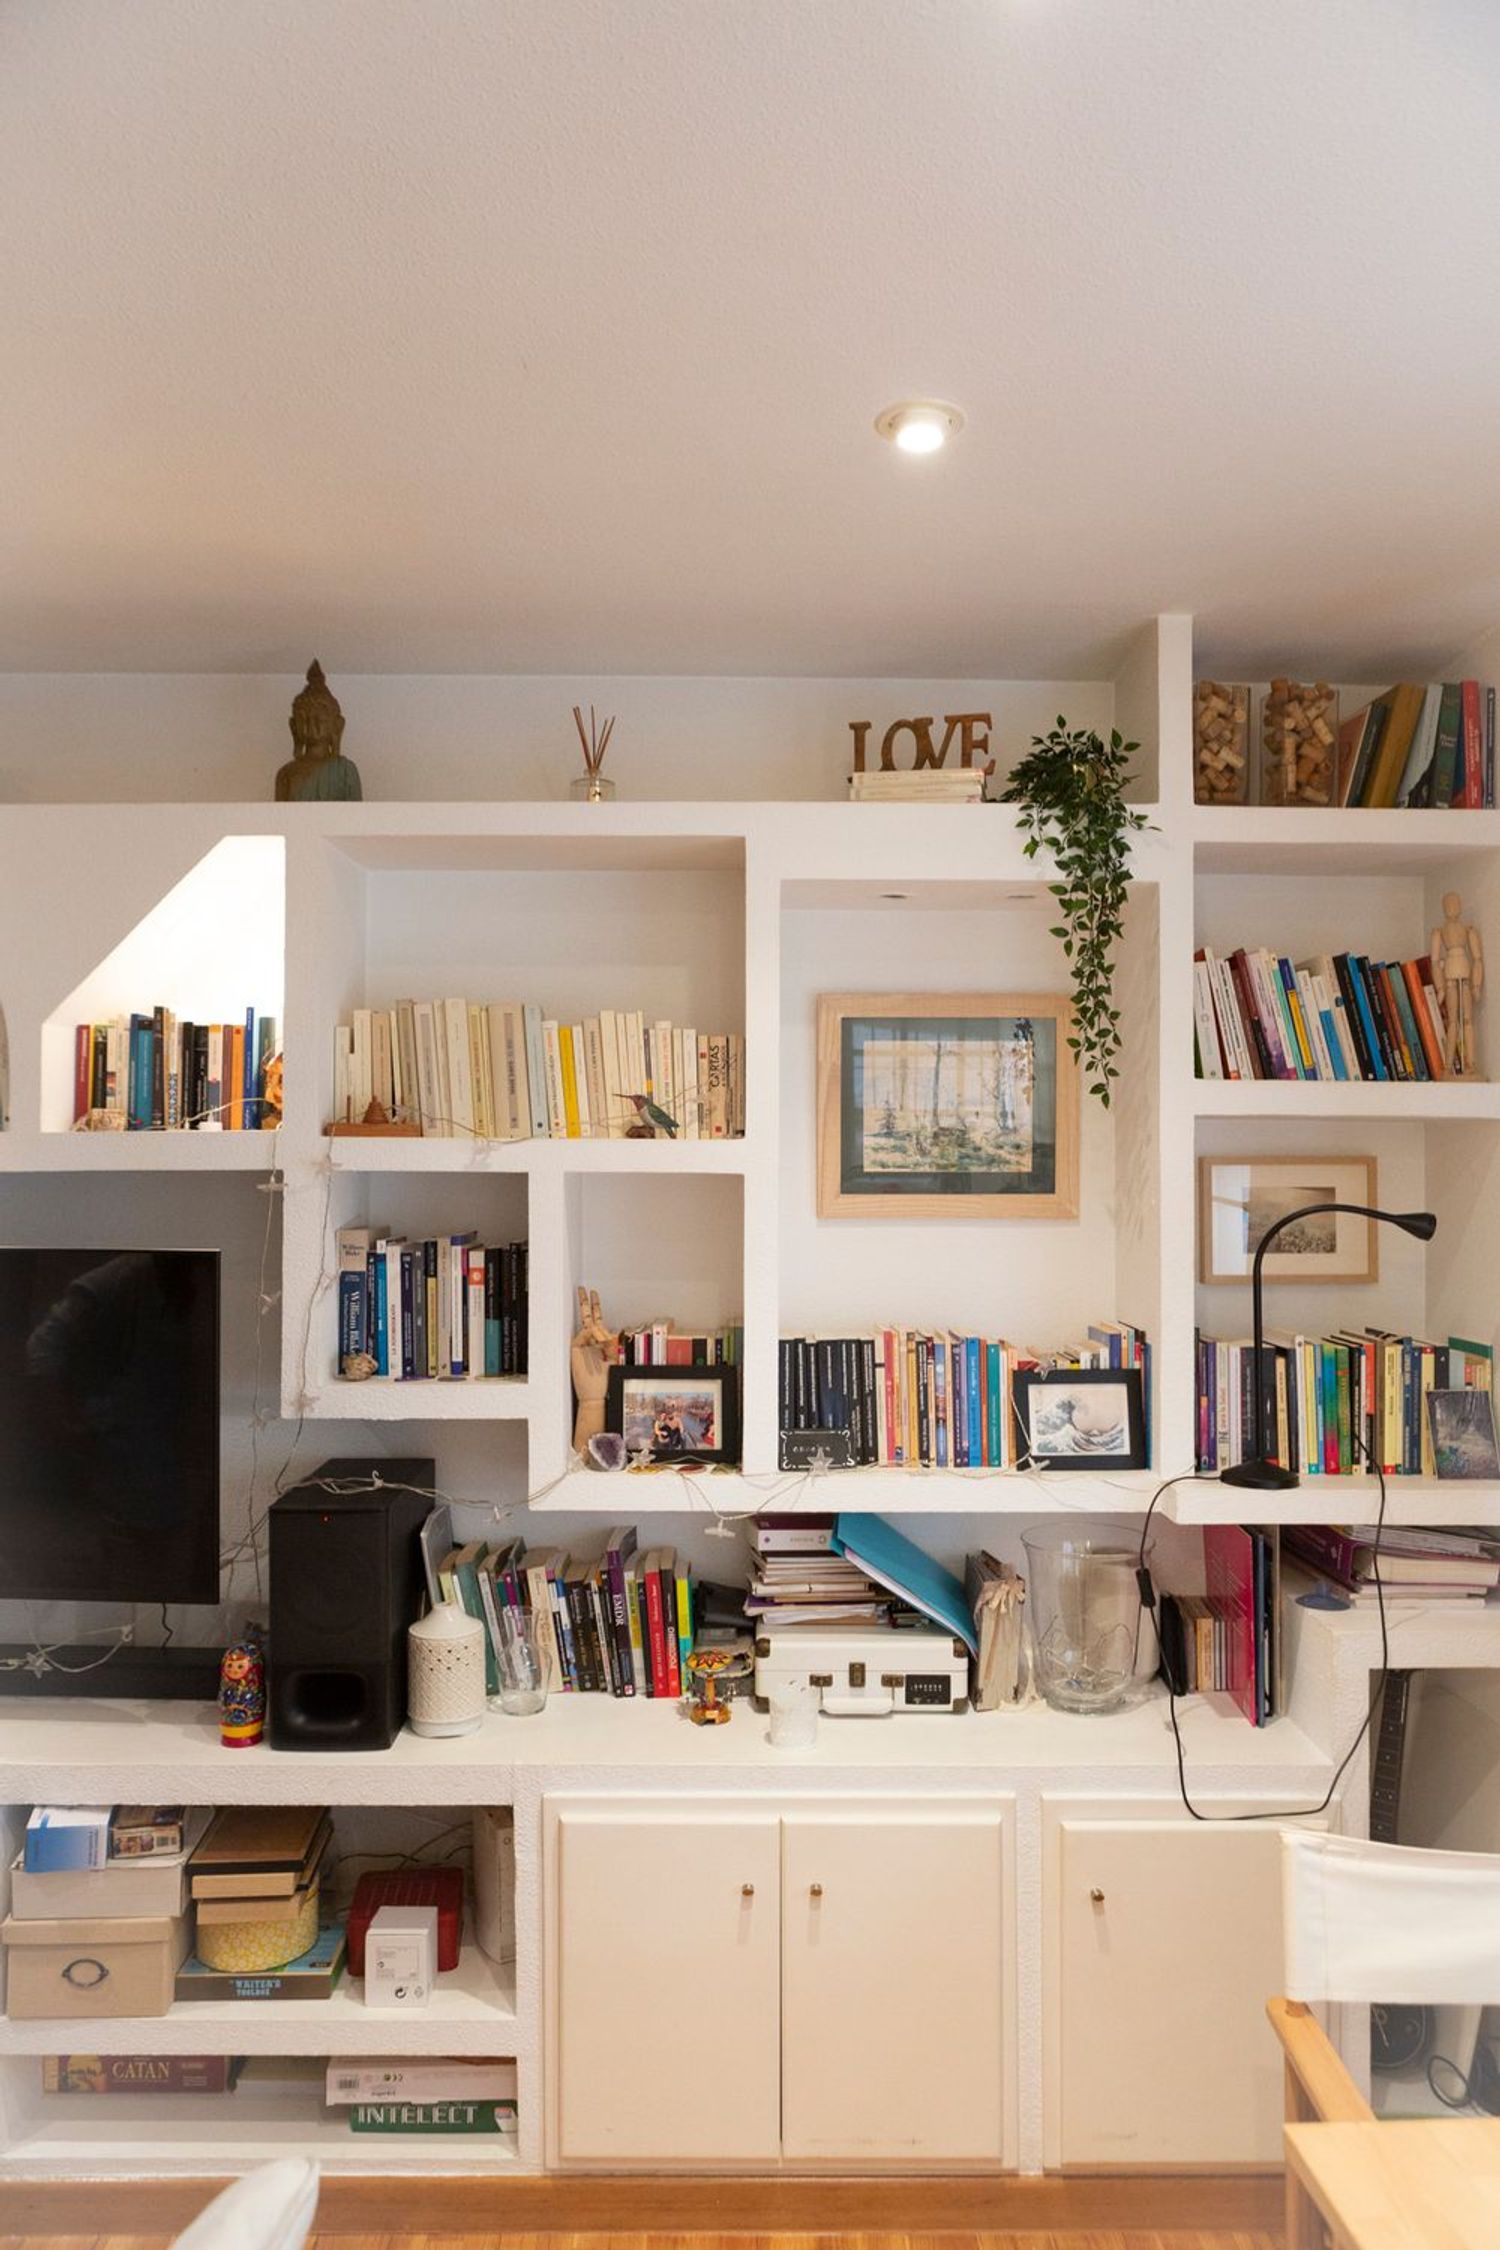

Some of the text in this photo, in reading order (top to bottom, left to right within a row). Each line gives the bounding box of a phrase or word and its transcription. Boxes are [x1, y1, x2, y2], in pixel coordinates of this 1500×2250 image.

[848, 712, 997, 776] LOVE
[349, 1291, 360, 1329] William
[612, 1593, 625, 1628] EMDR
[111, 2061, 171, 2079] CATAN
[357, 2105, 479, 2125] INTELECT
